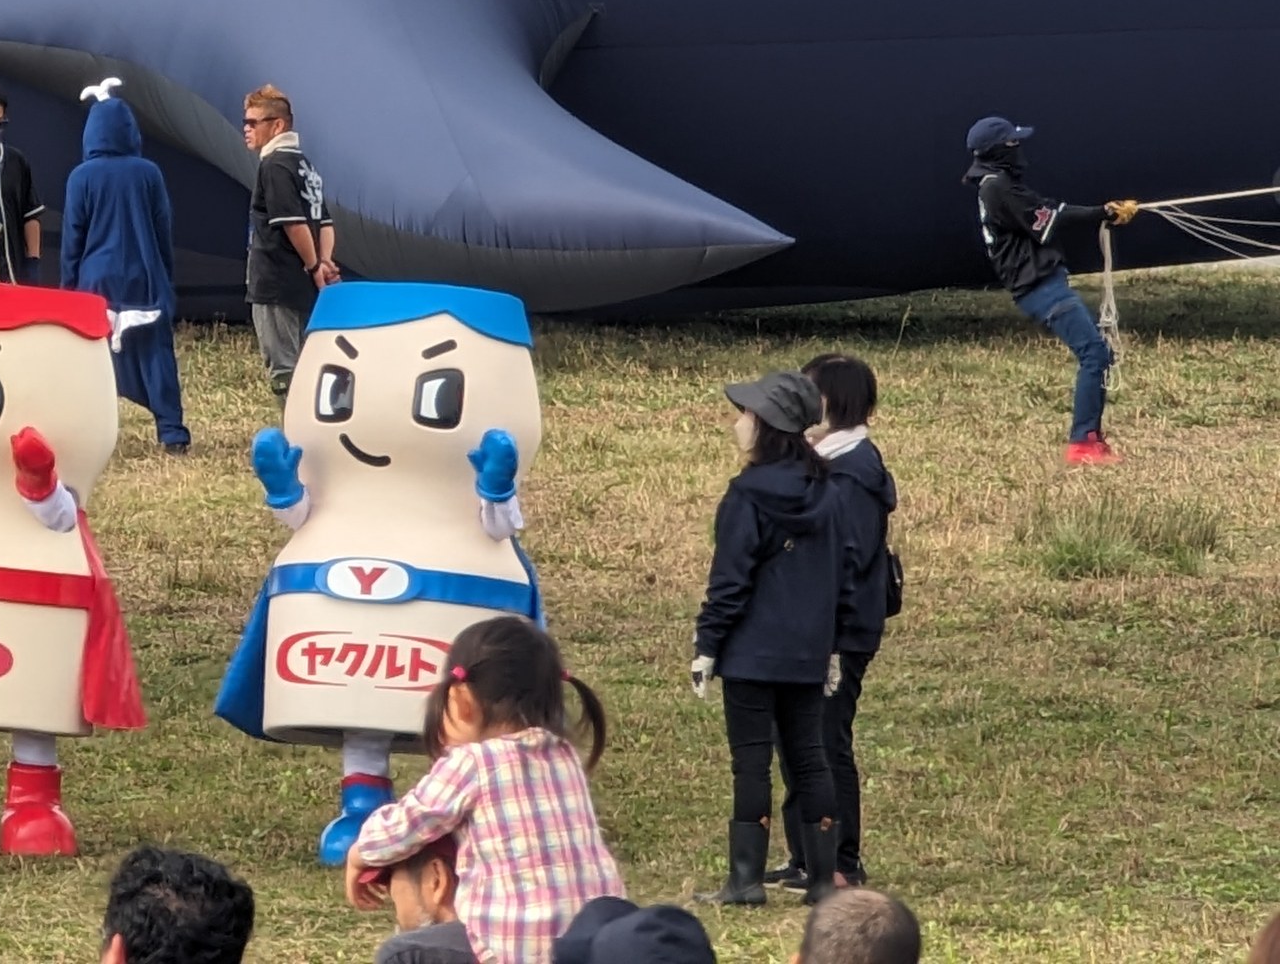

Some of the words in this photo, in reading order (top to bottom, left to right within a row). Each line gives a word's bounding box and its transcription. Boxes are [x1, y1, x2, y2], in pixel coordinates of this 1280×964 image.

[349, 567, 388, 595] Y
[300, 641, 438, 682] ヤクルト
